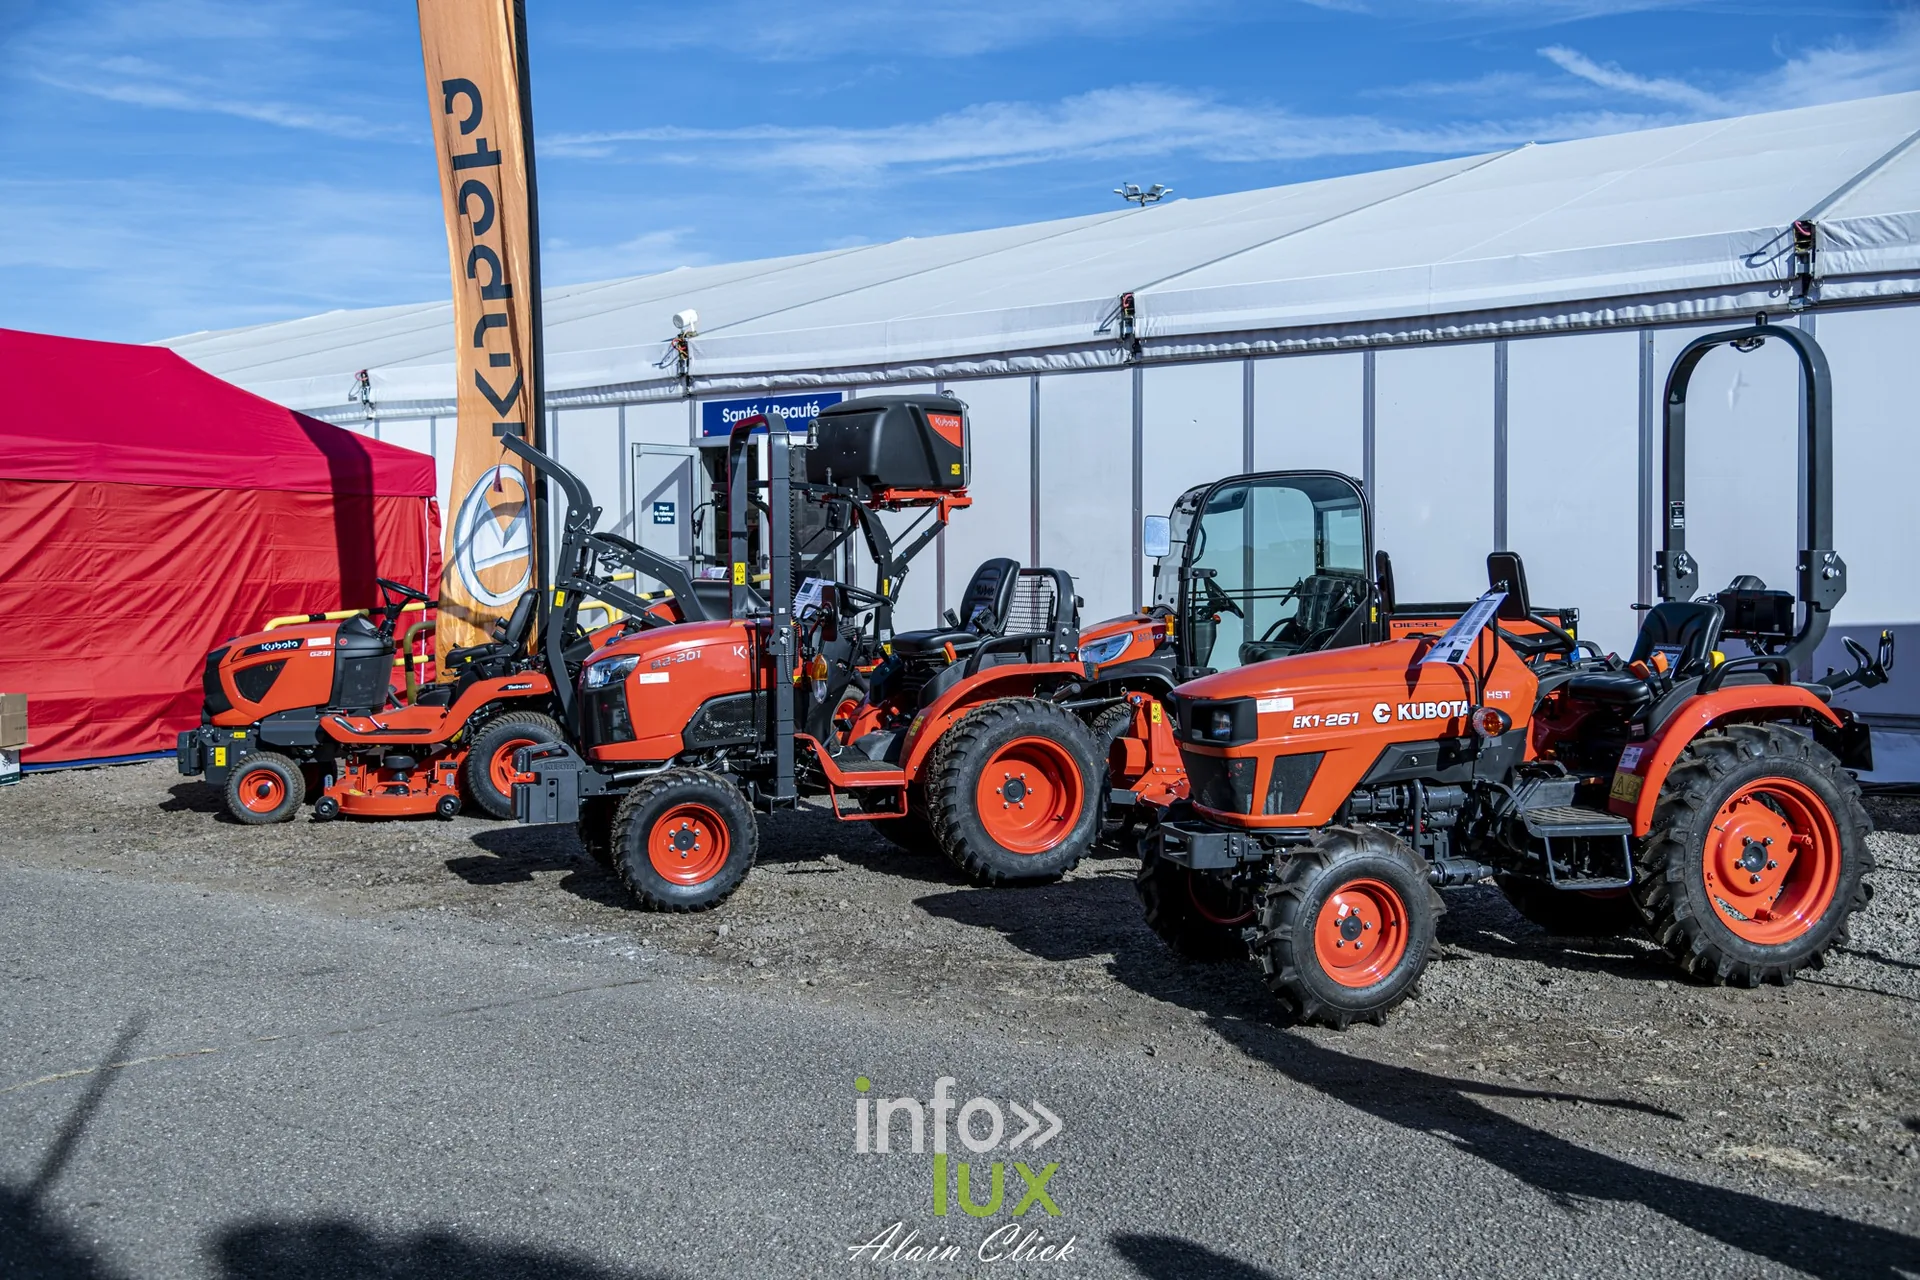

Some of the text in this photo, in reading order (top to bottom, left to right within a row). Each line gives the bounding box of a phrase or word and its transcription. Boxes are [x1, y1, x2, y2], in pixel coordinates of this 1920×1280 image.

[722, 405, 759, 423] Santé
[772, 400, 820, 419] Beauté
[935, 417, 959, 428] Kubota
[261, 640, 298, 651] Kubota
[1486, 690, 1511, 699] HST
[1397, 700, 1469, 721] KUBOTA
[1292, 711, 1360, 730] EK1-261
